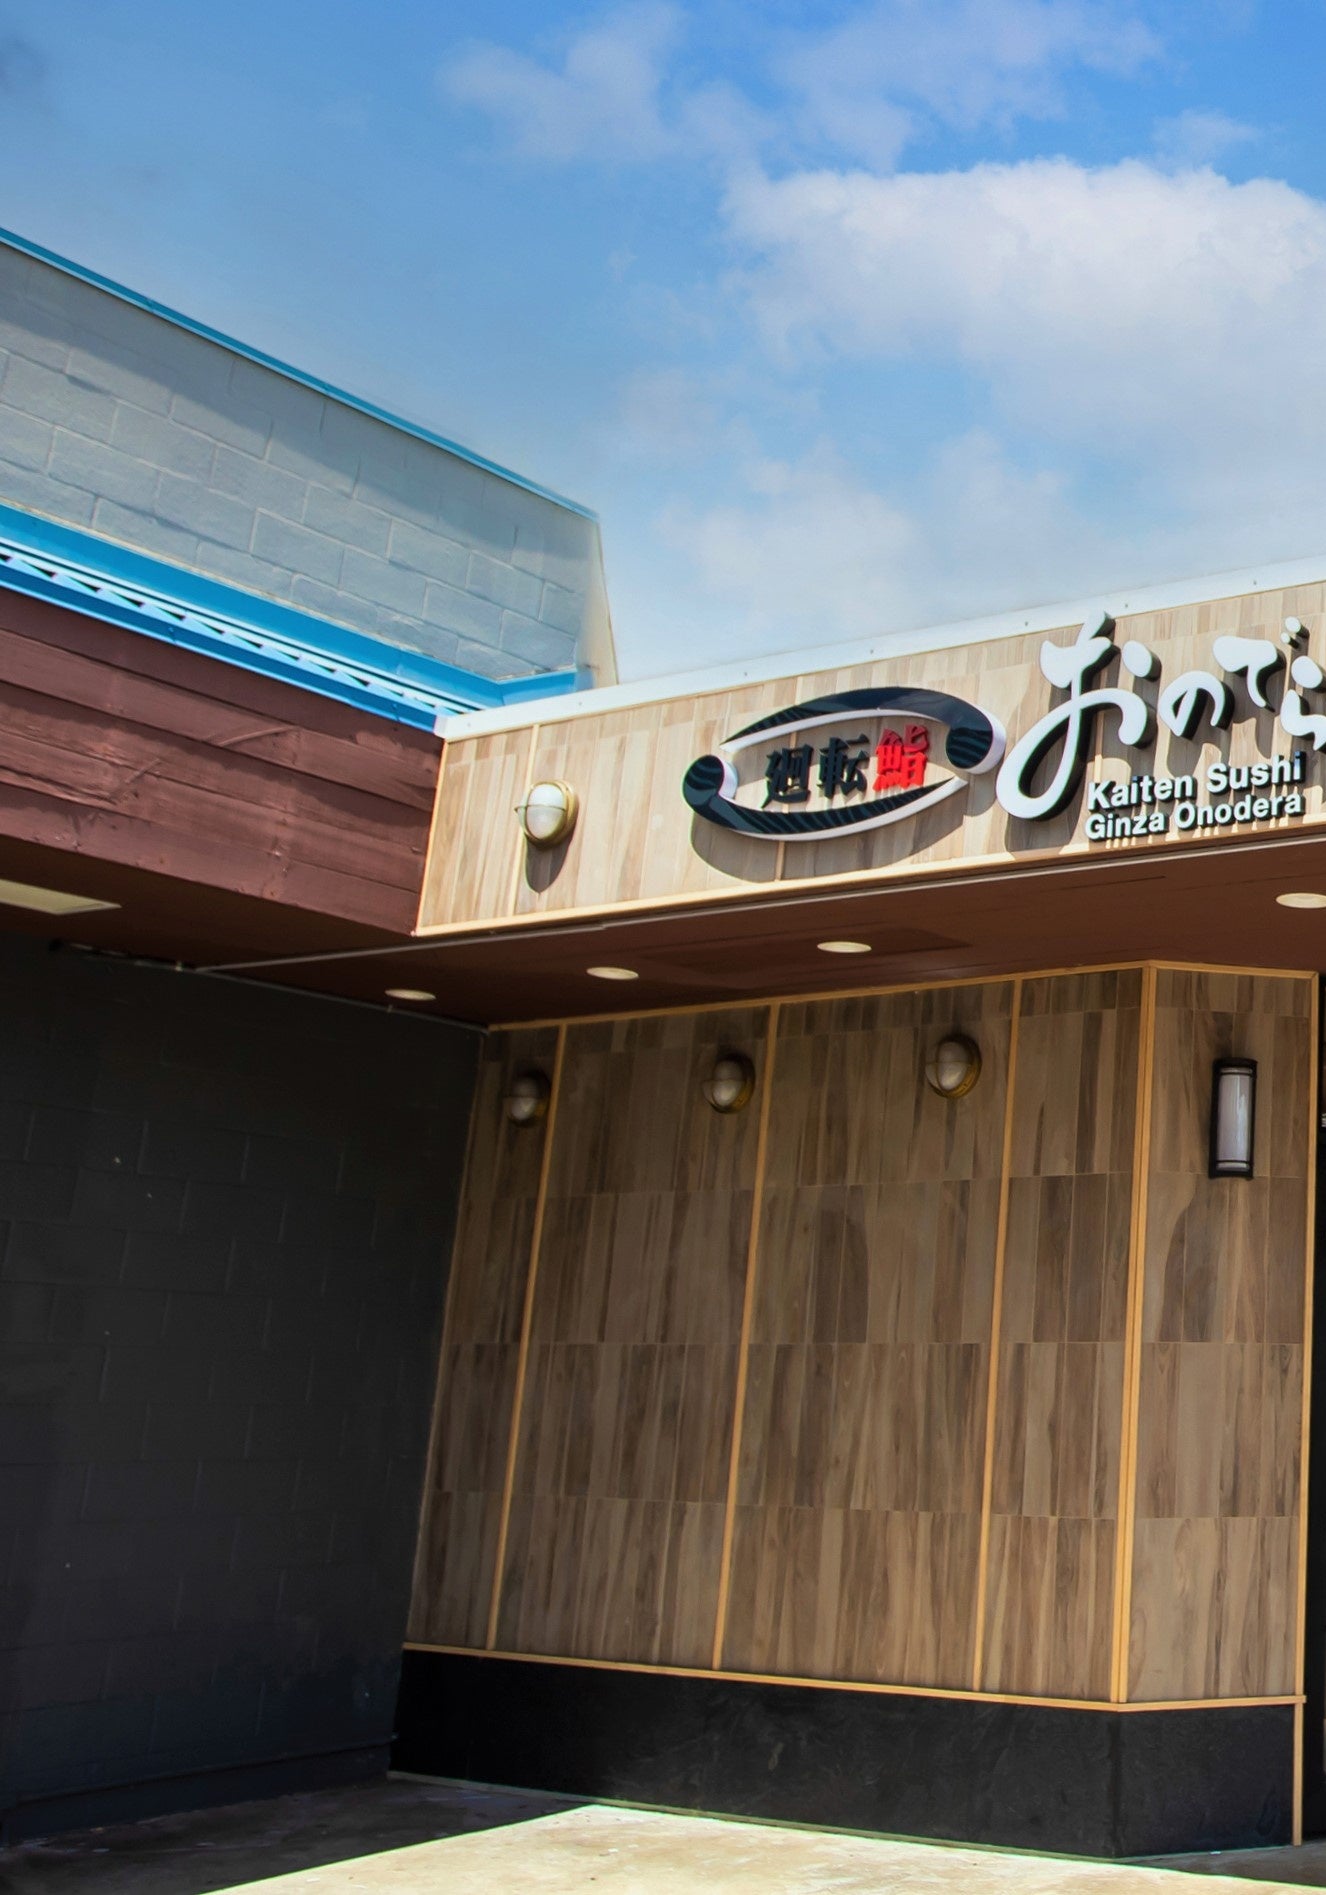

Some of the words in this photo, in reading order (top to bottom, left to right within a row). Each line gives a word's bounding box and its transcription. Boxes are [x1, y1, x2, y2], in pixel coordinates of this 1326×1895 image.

[762, 724, 929, 809] 廻転鮨
[1087, 774, 1196, 811] Kaiten
[1206, 751, 1306, 794] Sushi
[1084, 811, 1166, 841] Ginza
[1174, 793, 1304, 830] Onodera
